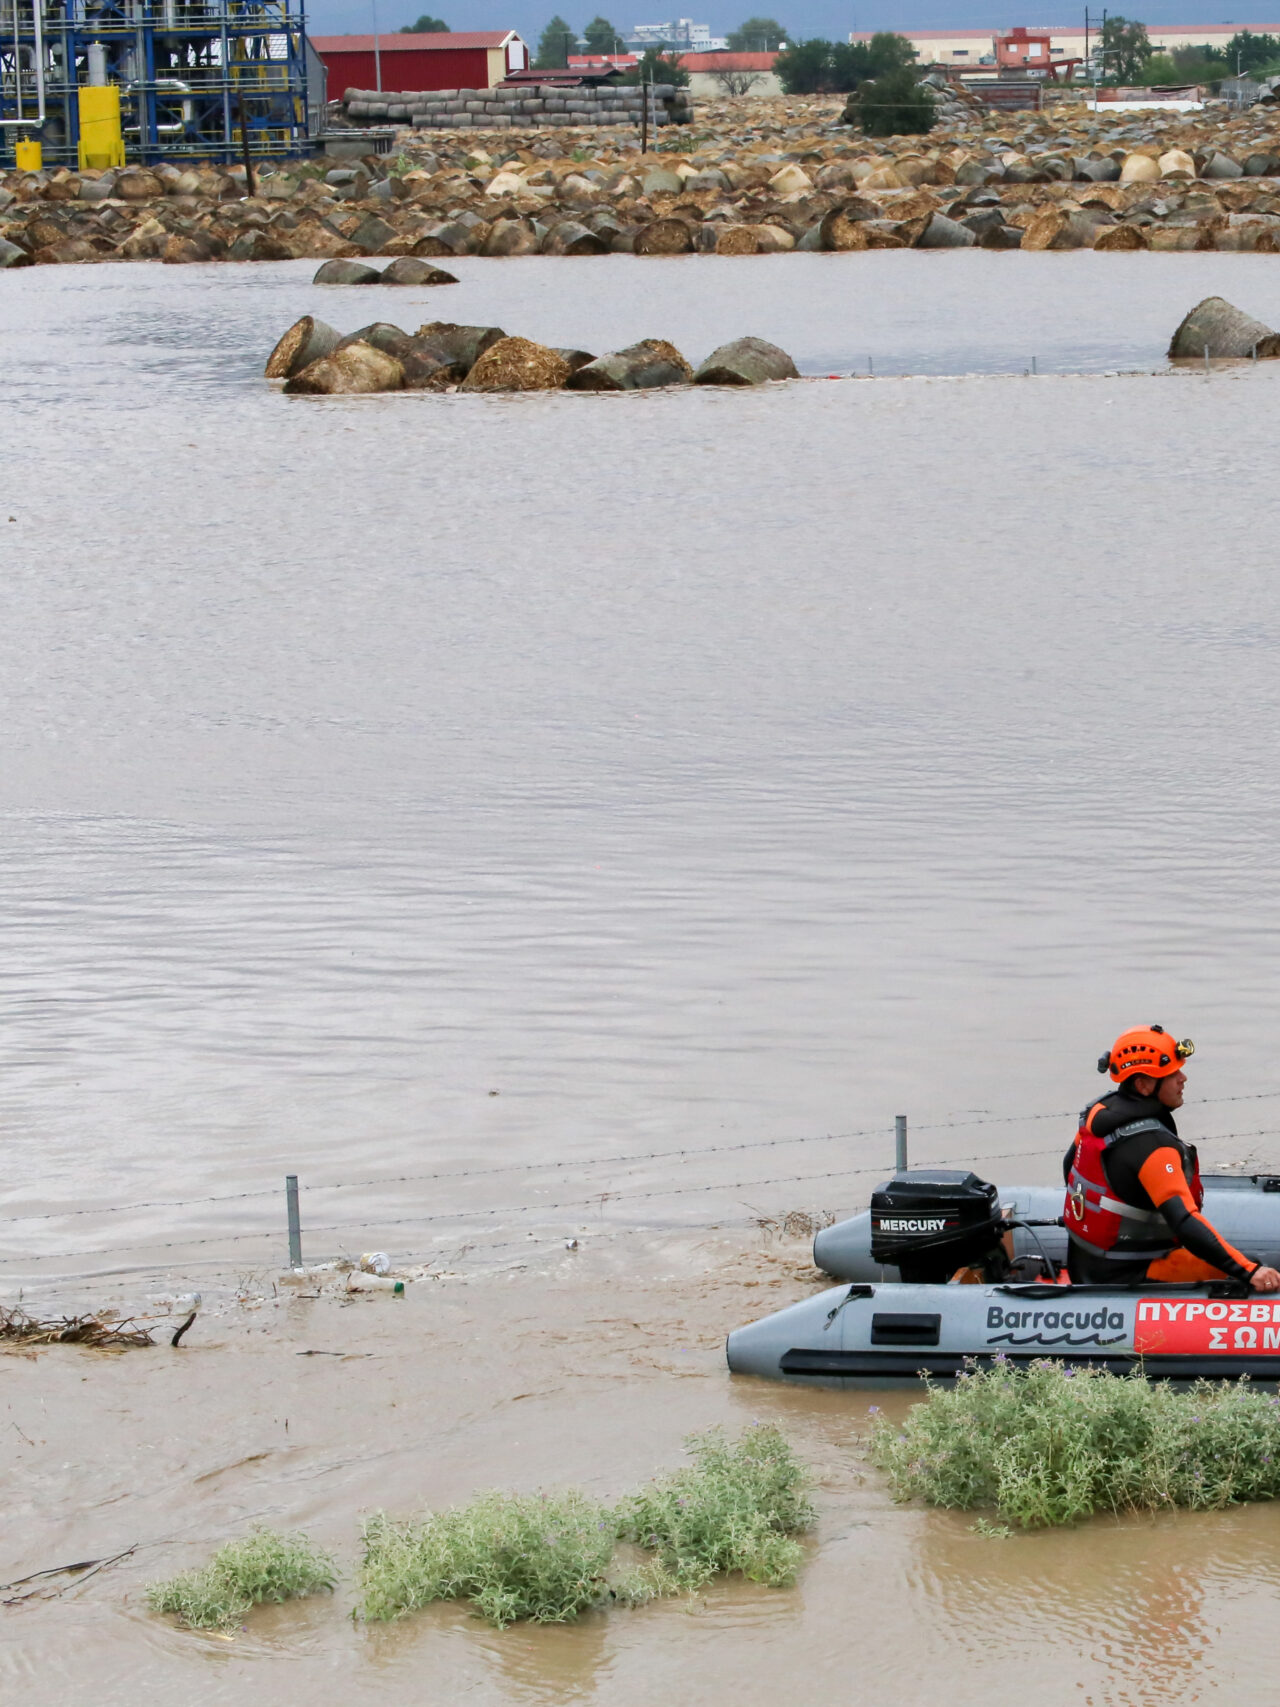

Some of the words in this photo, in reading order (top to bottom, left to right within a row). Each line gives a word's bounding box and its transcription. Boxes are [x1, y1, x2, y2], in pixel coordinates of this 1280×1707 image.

[1165, 1163, 1174, 1173] 6
[880, 1219, 946, 1231] MERCURY
[986, 1306, 1124, 1329] Barracuda
